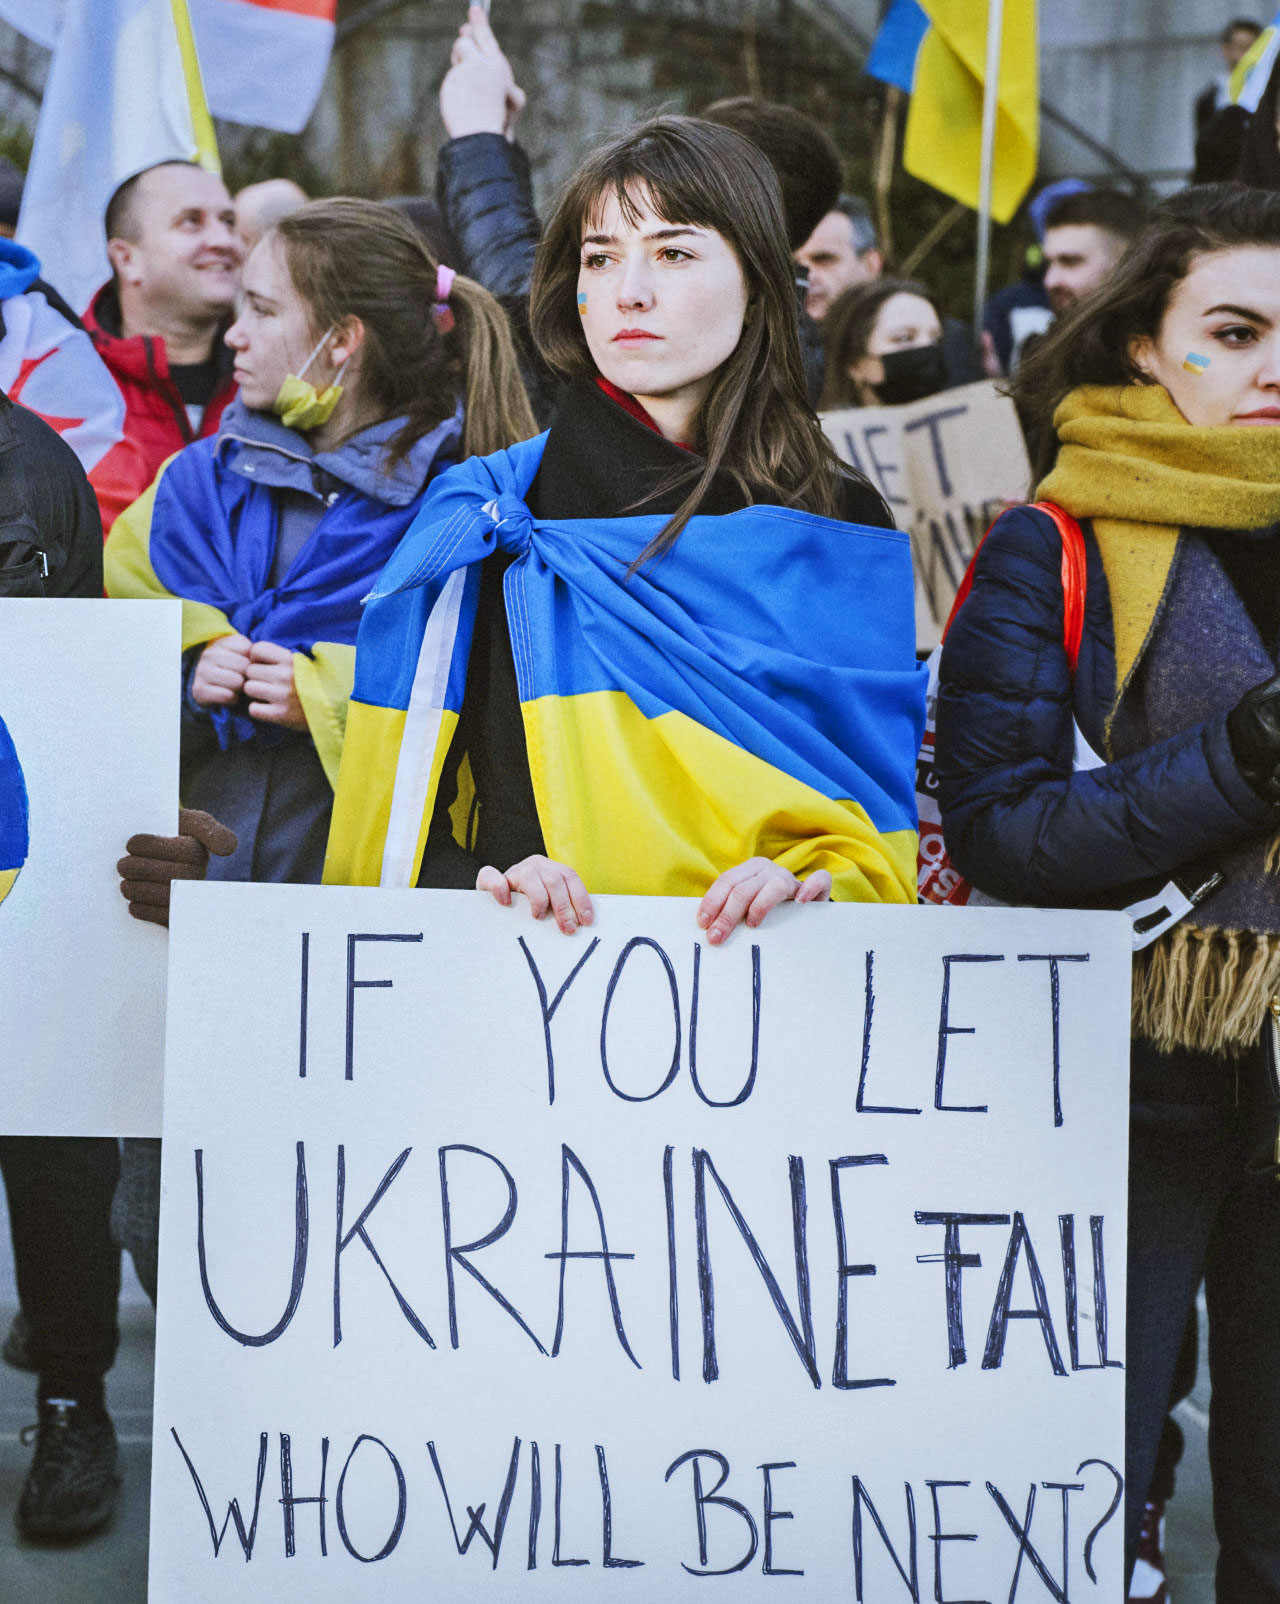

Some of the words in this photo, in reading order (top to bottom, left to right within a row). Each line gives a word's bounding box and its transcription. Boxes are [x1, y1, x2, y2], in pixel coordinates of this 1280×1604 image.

[299, 932, 424, 1081] IF
[517, 935, 762, 1108] YOU
[855, 949, 1090, 1128] LET
[194, 1140, 897, 1391] UKRAINE
[913, 1210, 1125, 1380] FALL
[170, 1426, 407, 1564] WHO
[425, 1435, 646, 1571] WILL
[664, 1448, 805, 1577] BE
[851, 1458, 1124, 1604] NEXT?
